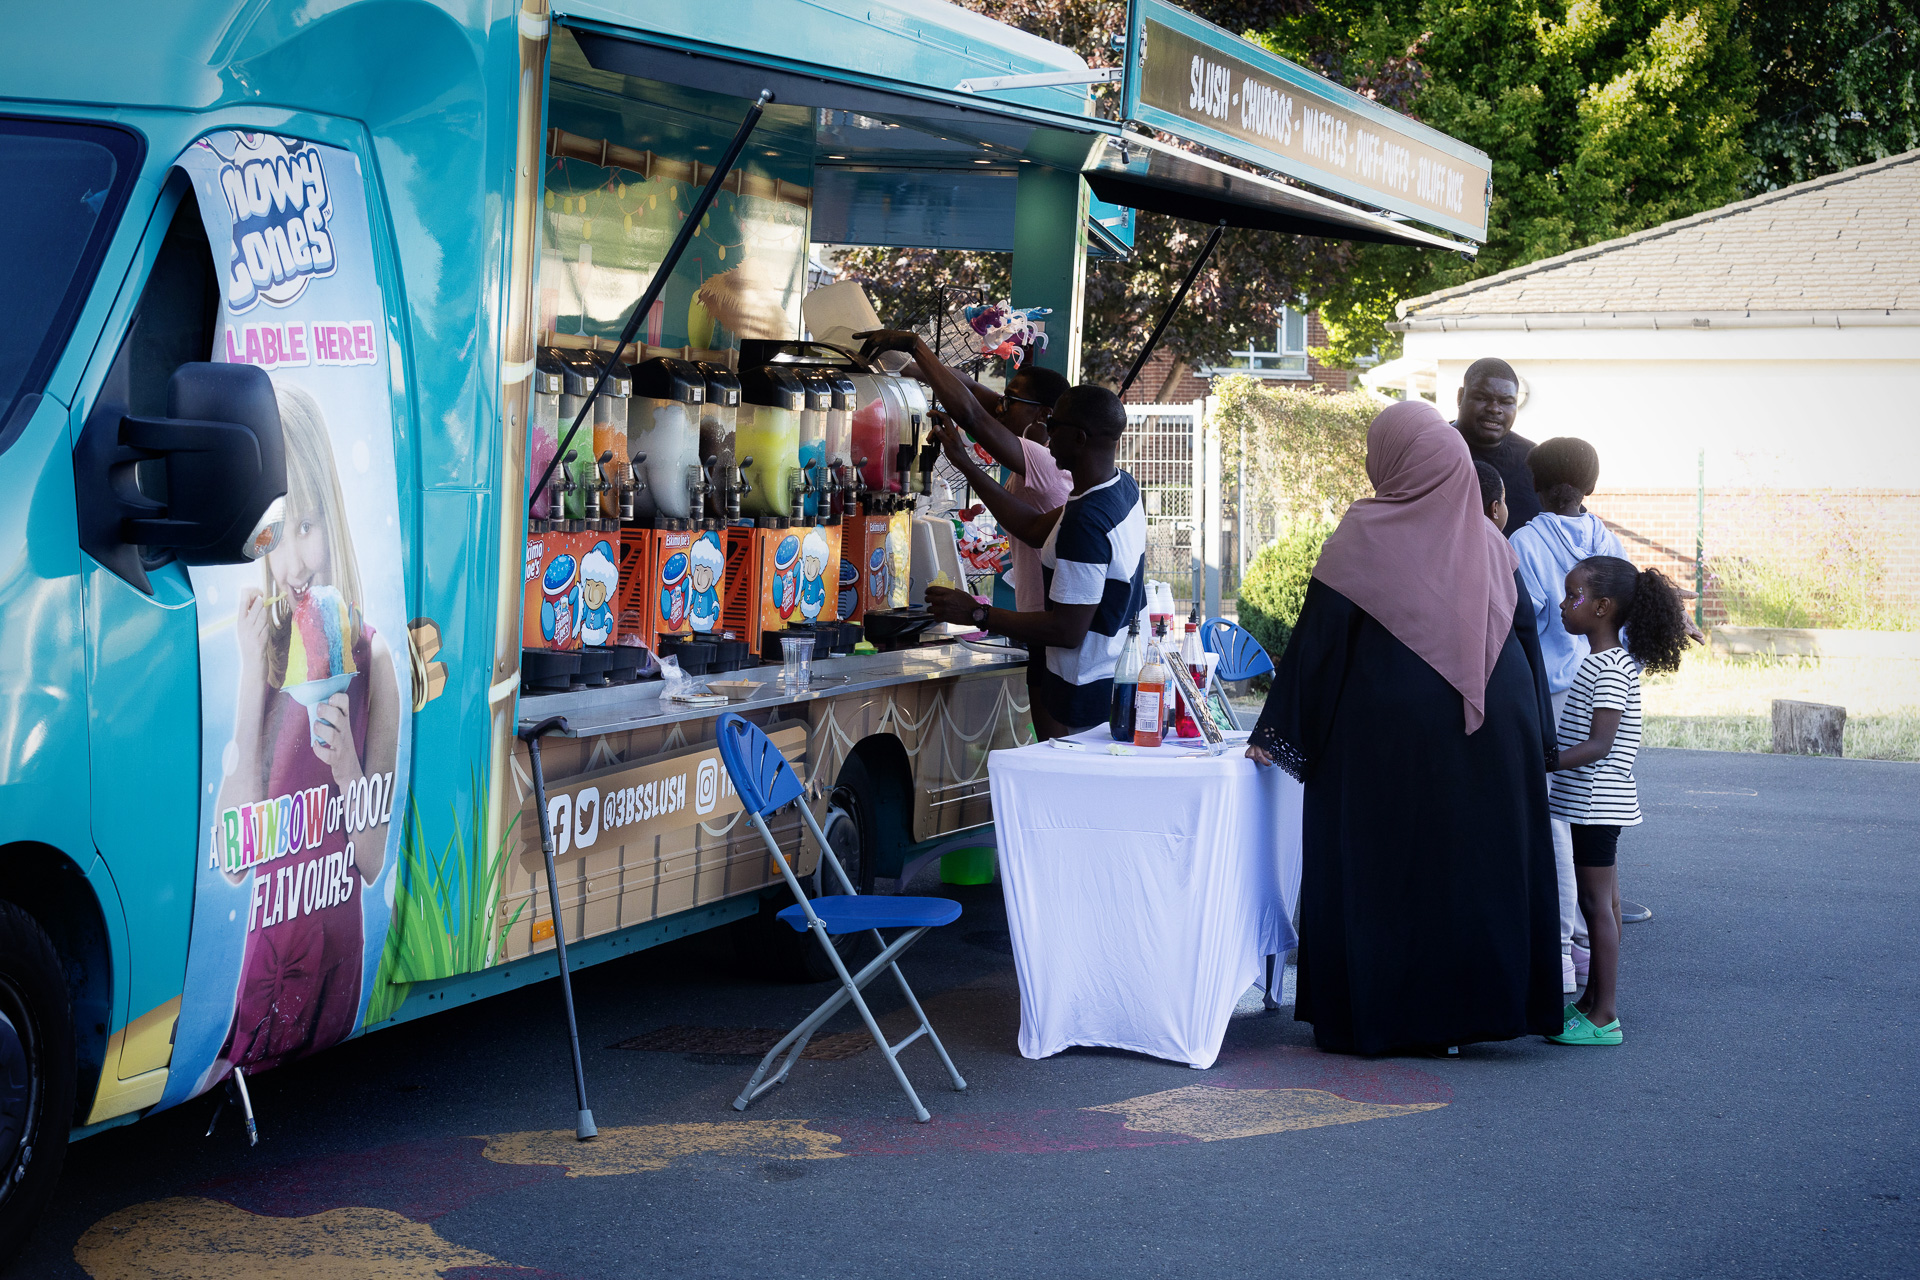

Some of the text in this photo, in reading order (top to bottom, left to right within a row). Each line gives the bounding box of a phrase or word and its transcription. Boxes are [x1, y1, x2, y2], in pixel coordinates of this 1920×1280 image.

[1189, 55, 1464, 214] SLUSH CHURROS WAFFLES PUFF-PUFFS JOLOFF RICE
[220, 149, 329, 225] nowy
[225, 325, 376, 365] LABLE HERE!
[525, 559, 540, 580] oe's
[526, 540, 543, 562] kimo
[208, 825, 220, 869] A
[222, 784, 329, 874] RAINBOW
[326, 795, 345, 834] OF
[603, 772, 687, 832] @3BSSLUSH
[249, 841, 355, 932] FLAVOURS
